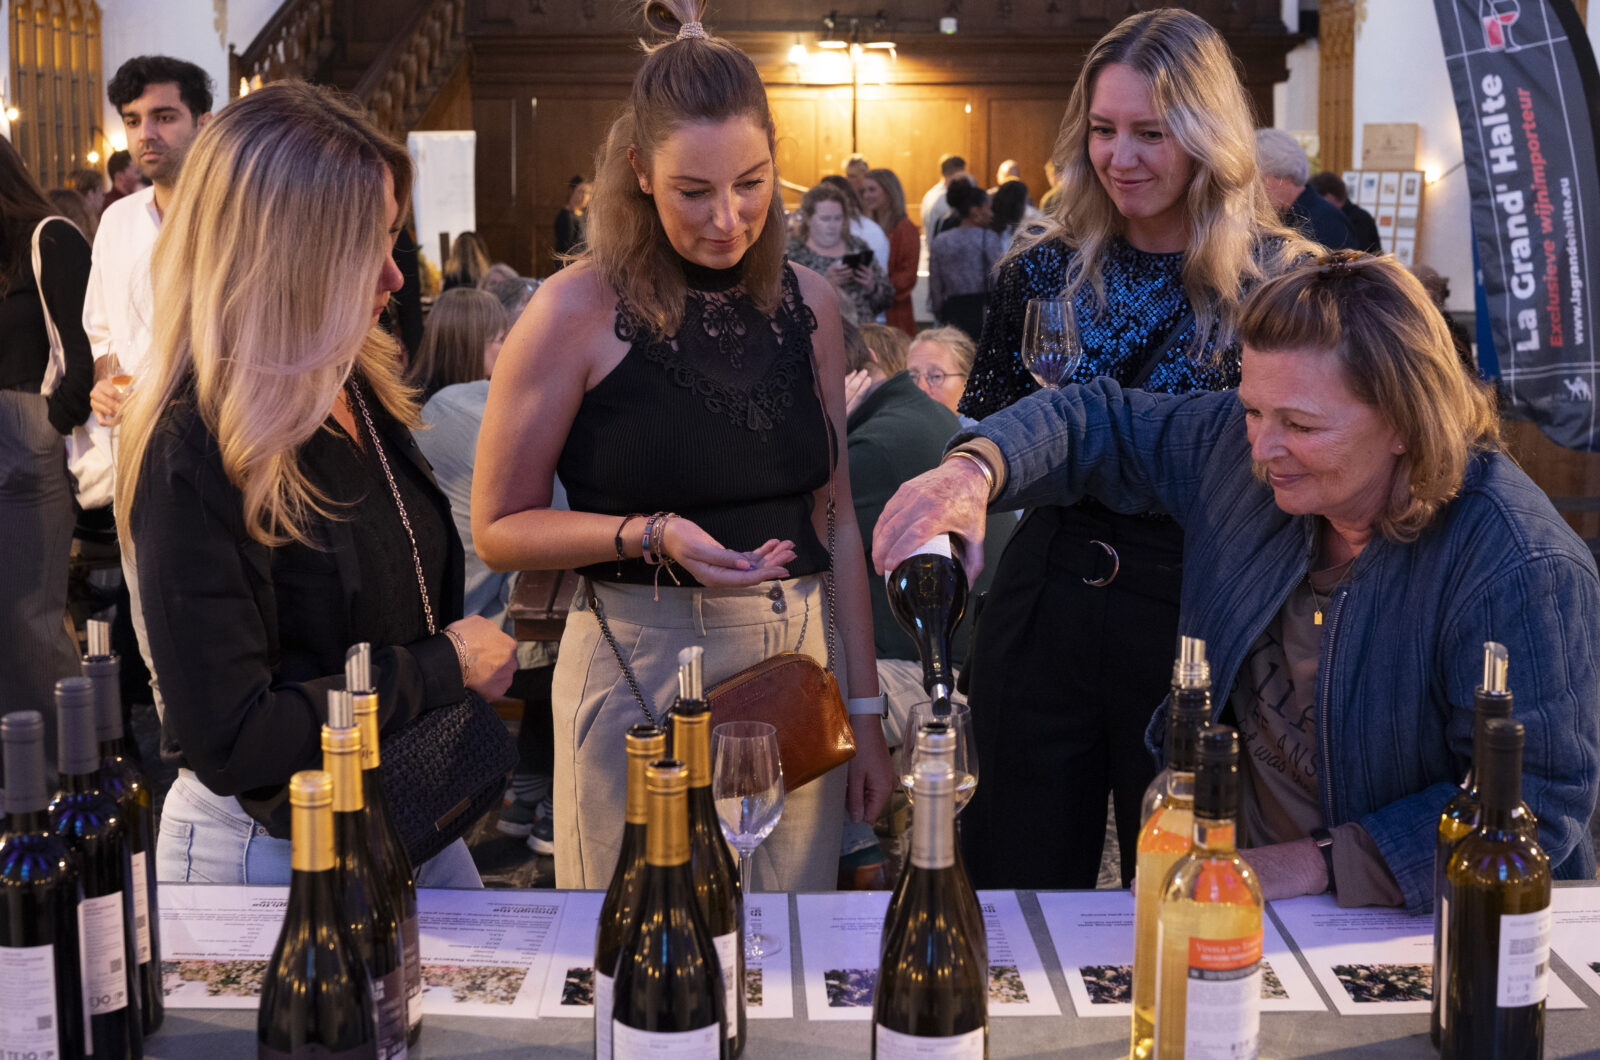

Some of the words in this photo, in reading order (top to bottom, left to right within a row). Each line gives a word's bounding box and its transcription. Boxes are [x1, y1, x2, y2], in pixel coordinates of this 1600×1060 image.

[1481, 73, 1518, 174] Halte
[1517, 87, 1555, 234] wijnimporteur
[1495, 184, 1536, 300] Grand'
[1538, 240, 1564, 348] Exclusieve
[1557, 176, 1584, 345] www.lagrandehalte.eu
[1516, 308, 1540, 352] La
